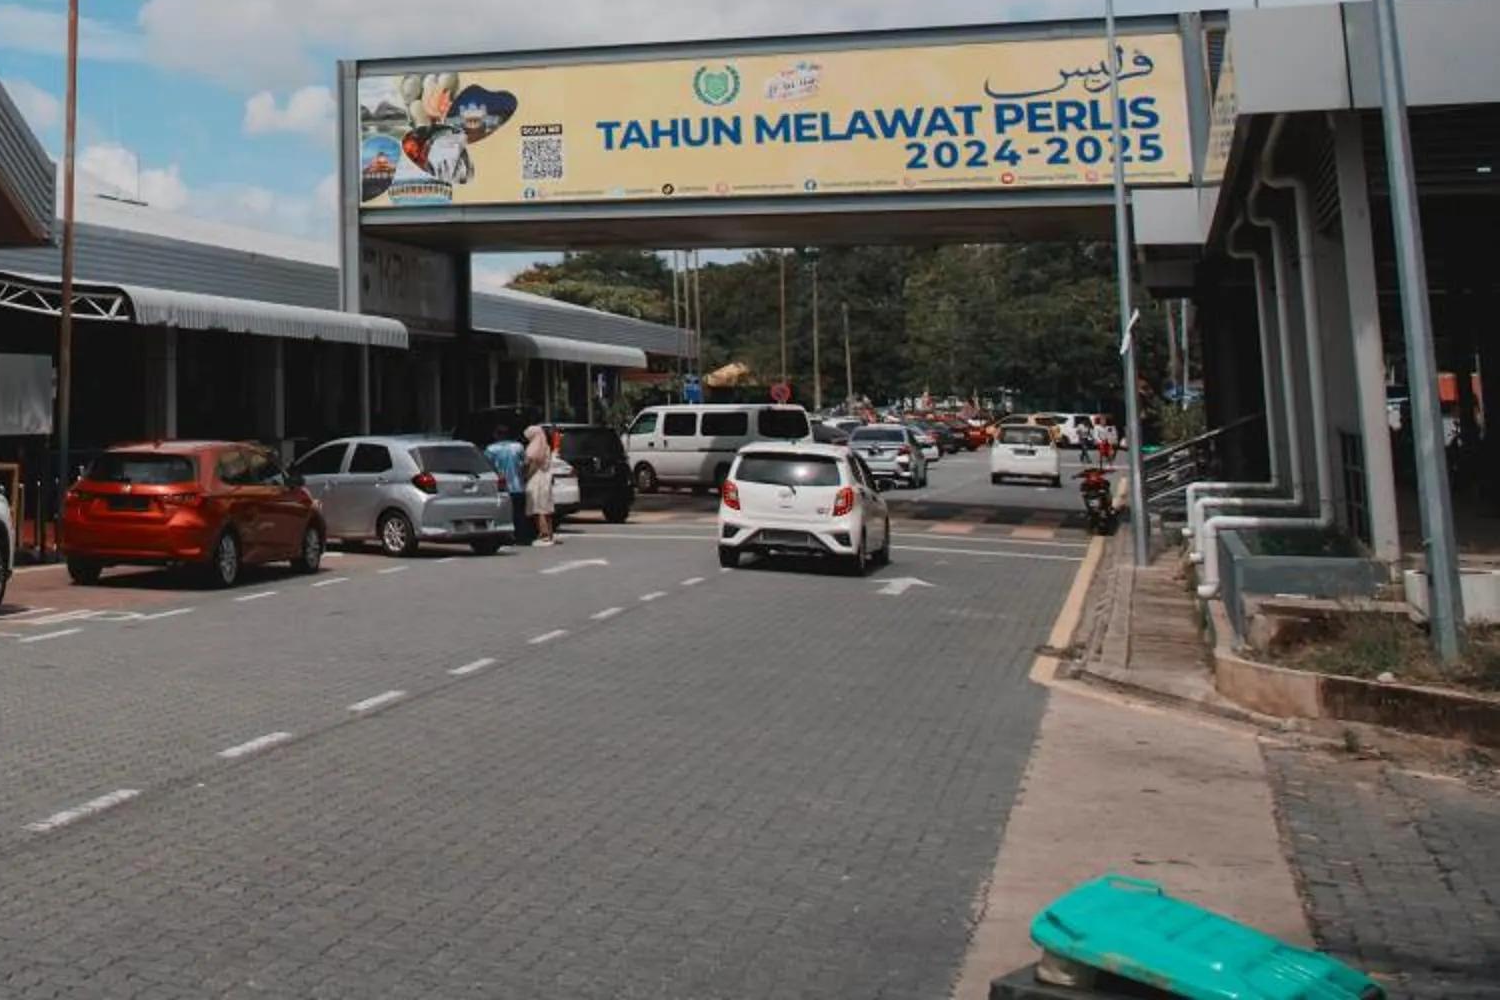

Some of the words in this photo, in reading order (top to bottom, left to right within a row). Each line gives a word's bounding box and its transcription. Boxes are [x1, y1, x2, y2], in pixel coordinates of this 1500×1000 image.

[596, 116, 742, 150] TAHUN
[755, 104, 981, 142] MELAWAT
[995, 96, 1159, 134] PERLIS
[905, 134, 1164, 170] 2024-2025
